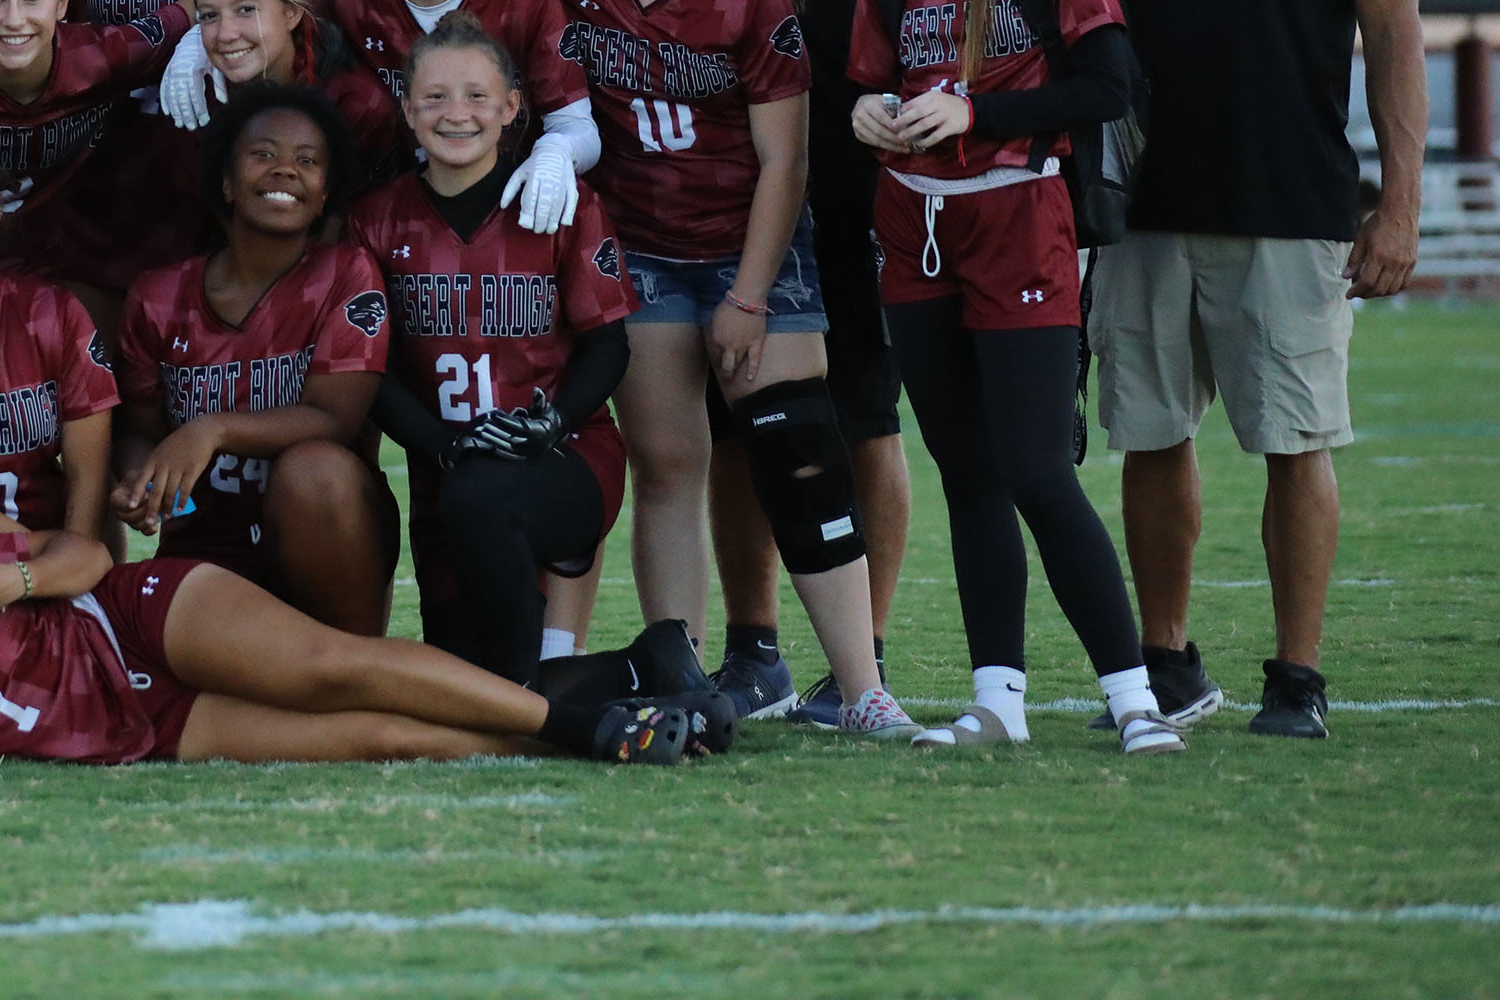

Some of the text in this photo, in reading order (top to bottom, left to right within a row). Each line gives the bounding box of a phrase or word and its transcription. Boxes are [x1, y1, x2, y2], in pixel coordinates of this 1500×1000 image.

[629, 97, 697, 152] 10
[480, 274, 557, 337] RIDGE
[435, 353, 498, 422] 21
[210, 453, 270, 494] 24
